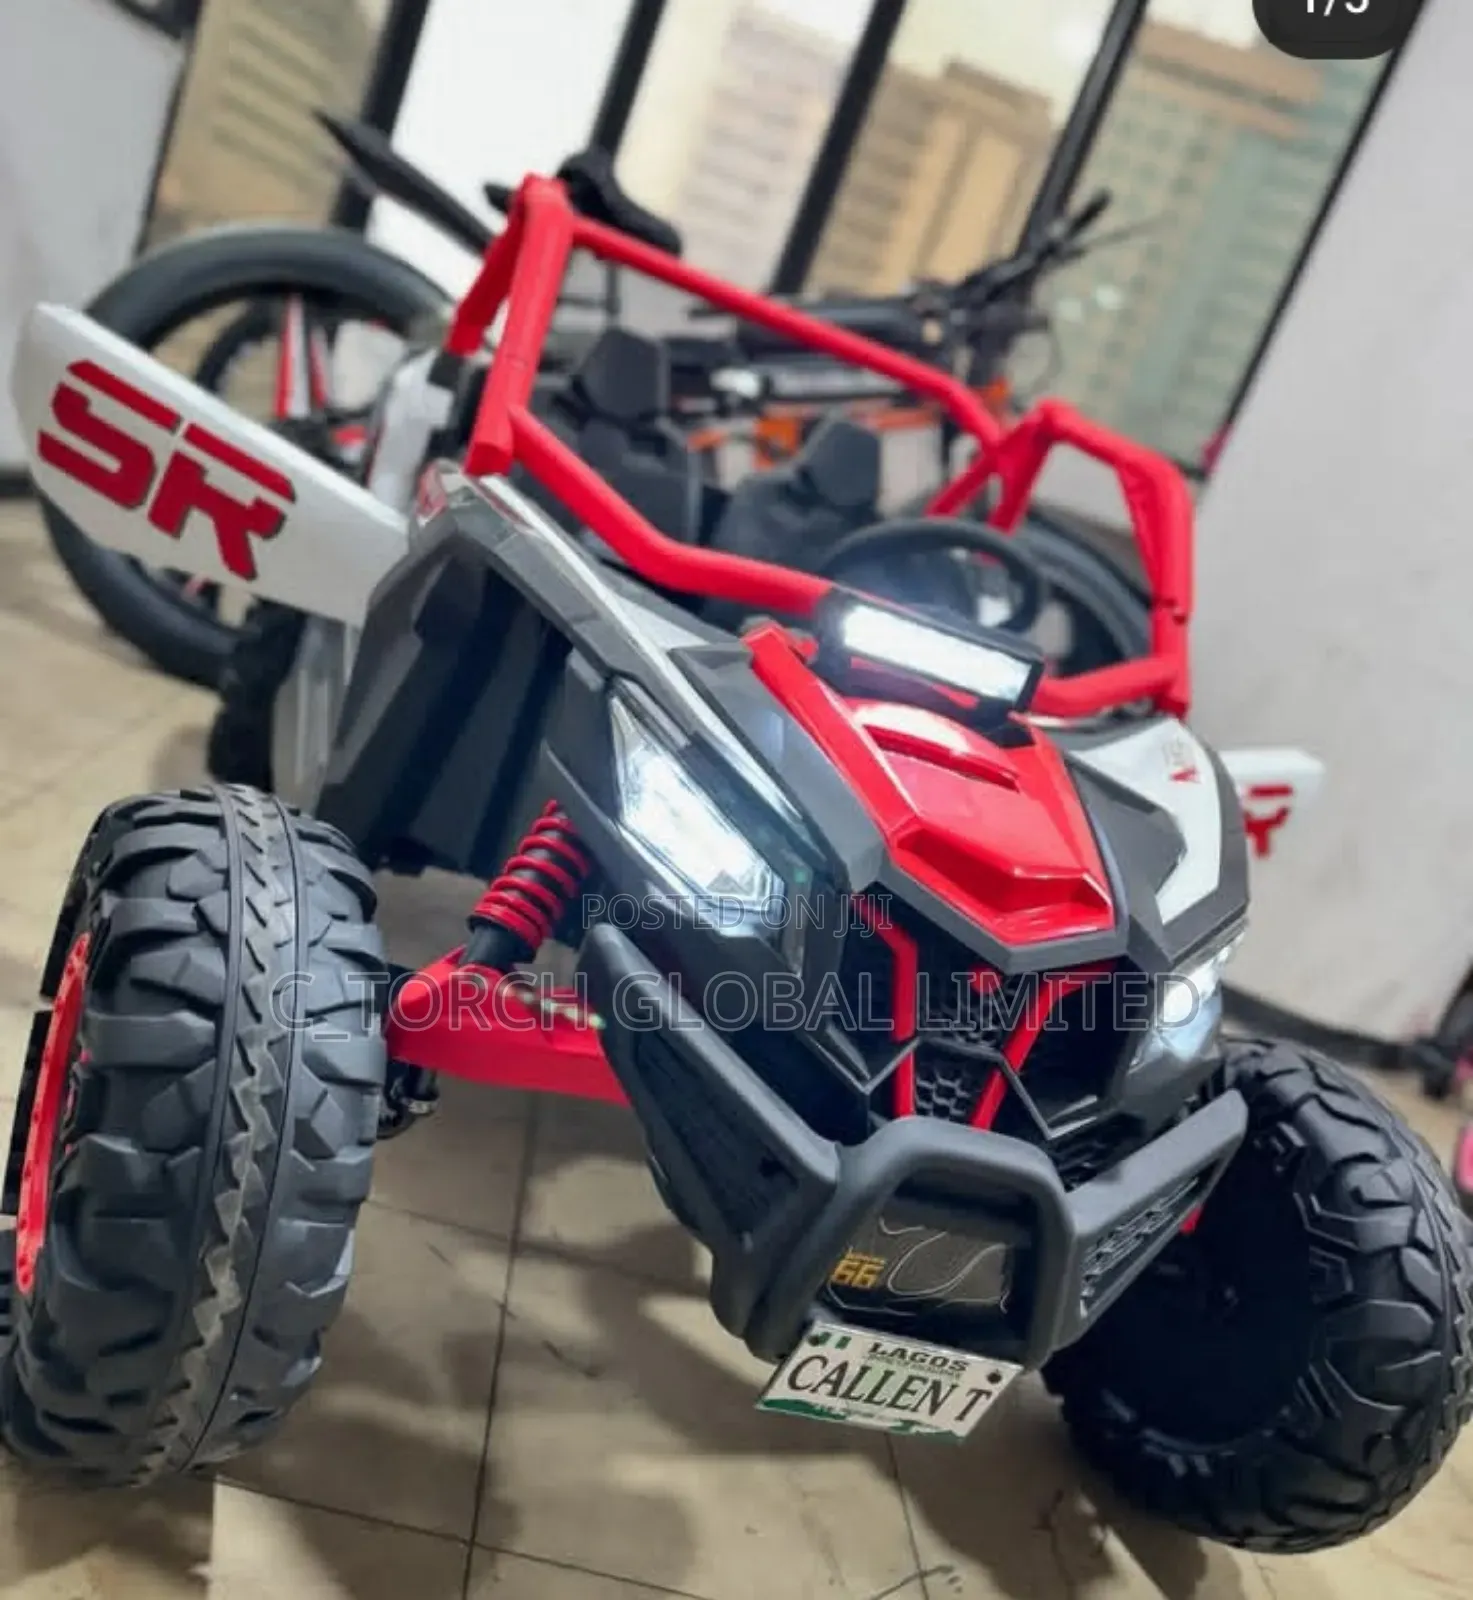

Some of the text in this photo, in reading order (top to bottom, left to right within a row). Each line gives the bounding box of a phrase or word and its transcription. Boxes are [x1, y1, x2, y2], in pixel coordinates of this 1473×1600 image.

[37, 358, 297, 582] SR
[831, 1258, 884, 1289] 66
[867, 1341, 970, 1373] LAGOS
[787, 1353, 960, 1418] CALLEN
[954, 1387, 992, 1422] T
